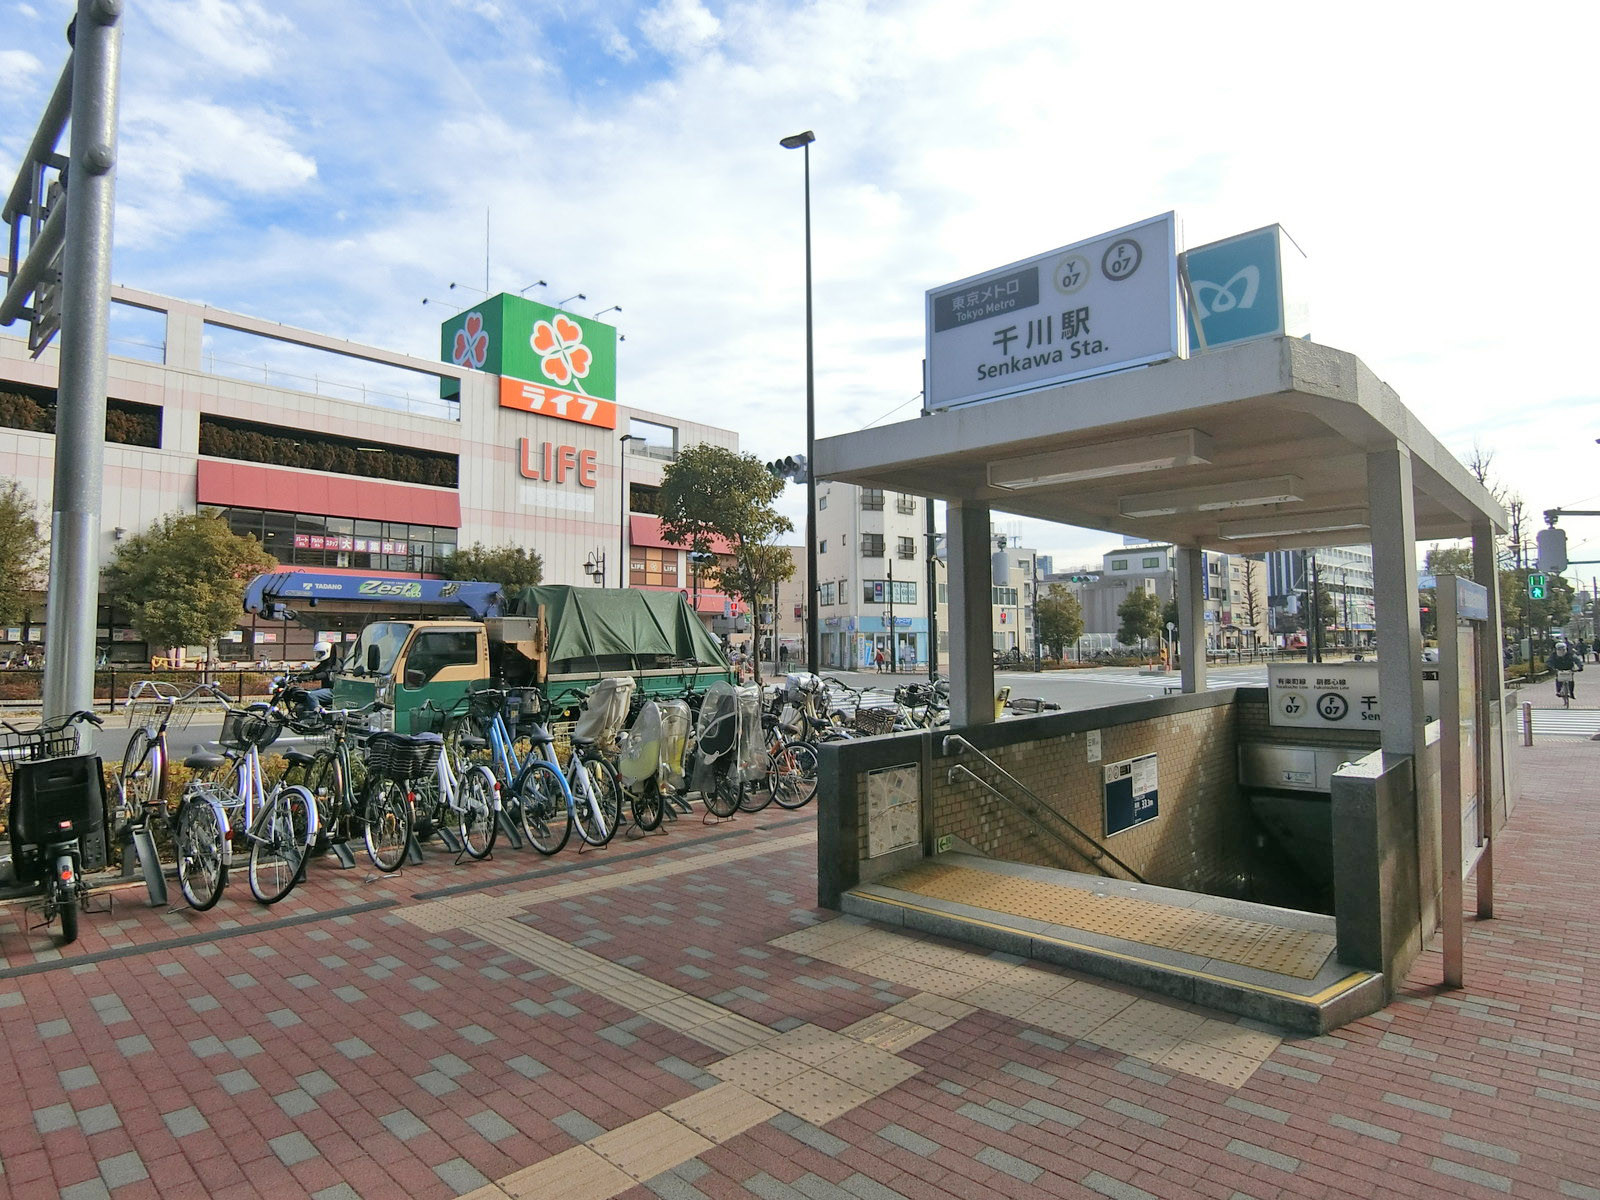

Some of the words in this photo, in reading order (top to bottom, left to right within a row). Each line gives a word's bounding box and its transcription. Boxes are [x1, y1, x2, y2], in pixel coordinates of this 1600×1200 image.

[1117, 246, 1125, 258] F
[1066, 261, 1075, 273] Y
[1111, 257, 1132, 274] 07
[1062, 272, 1081, 288] 07
[951, 278, 1020, 312] 東京メトロ
[956, 307, 984, 323] Tokyo
[985, 298, 1016, 316] Metro
[992, 306, 1091, 356] 千川駅
[976, 349, 1063, 381] Senkawa
[1070, 336, 1109, 359] Sta.
[521, 385, 598, 421] ライフ
[520, 437, 598, 488] LIFE
[631, 562, 645, 570] LIFE
[359, 580, 412, 596] Zest
[1289, 696, 1296, 704] Y
[1329, 697, 1335, 705] F
[1360, 696, 1378, 710] 千
[1285, 705, 1300, 713] 07
[1324, 706, 1340, 715] 07
[1361, 711, 1381, 721] Sen
